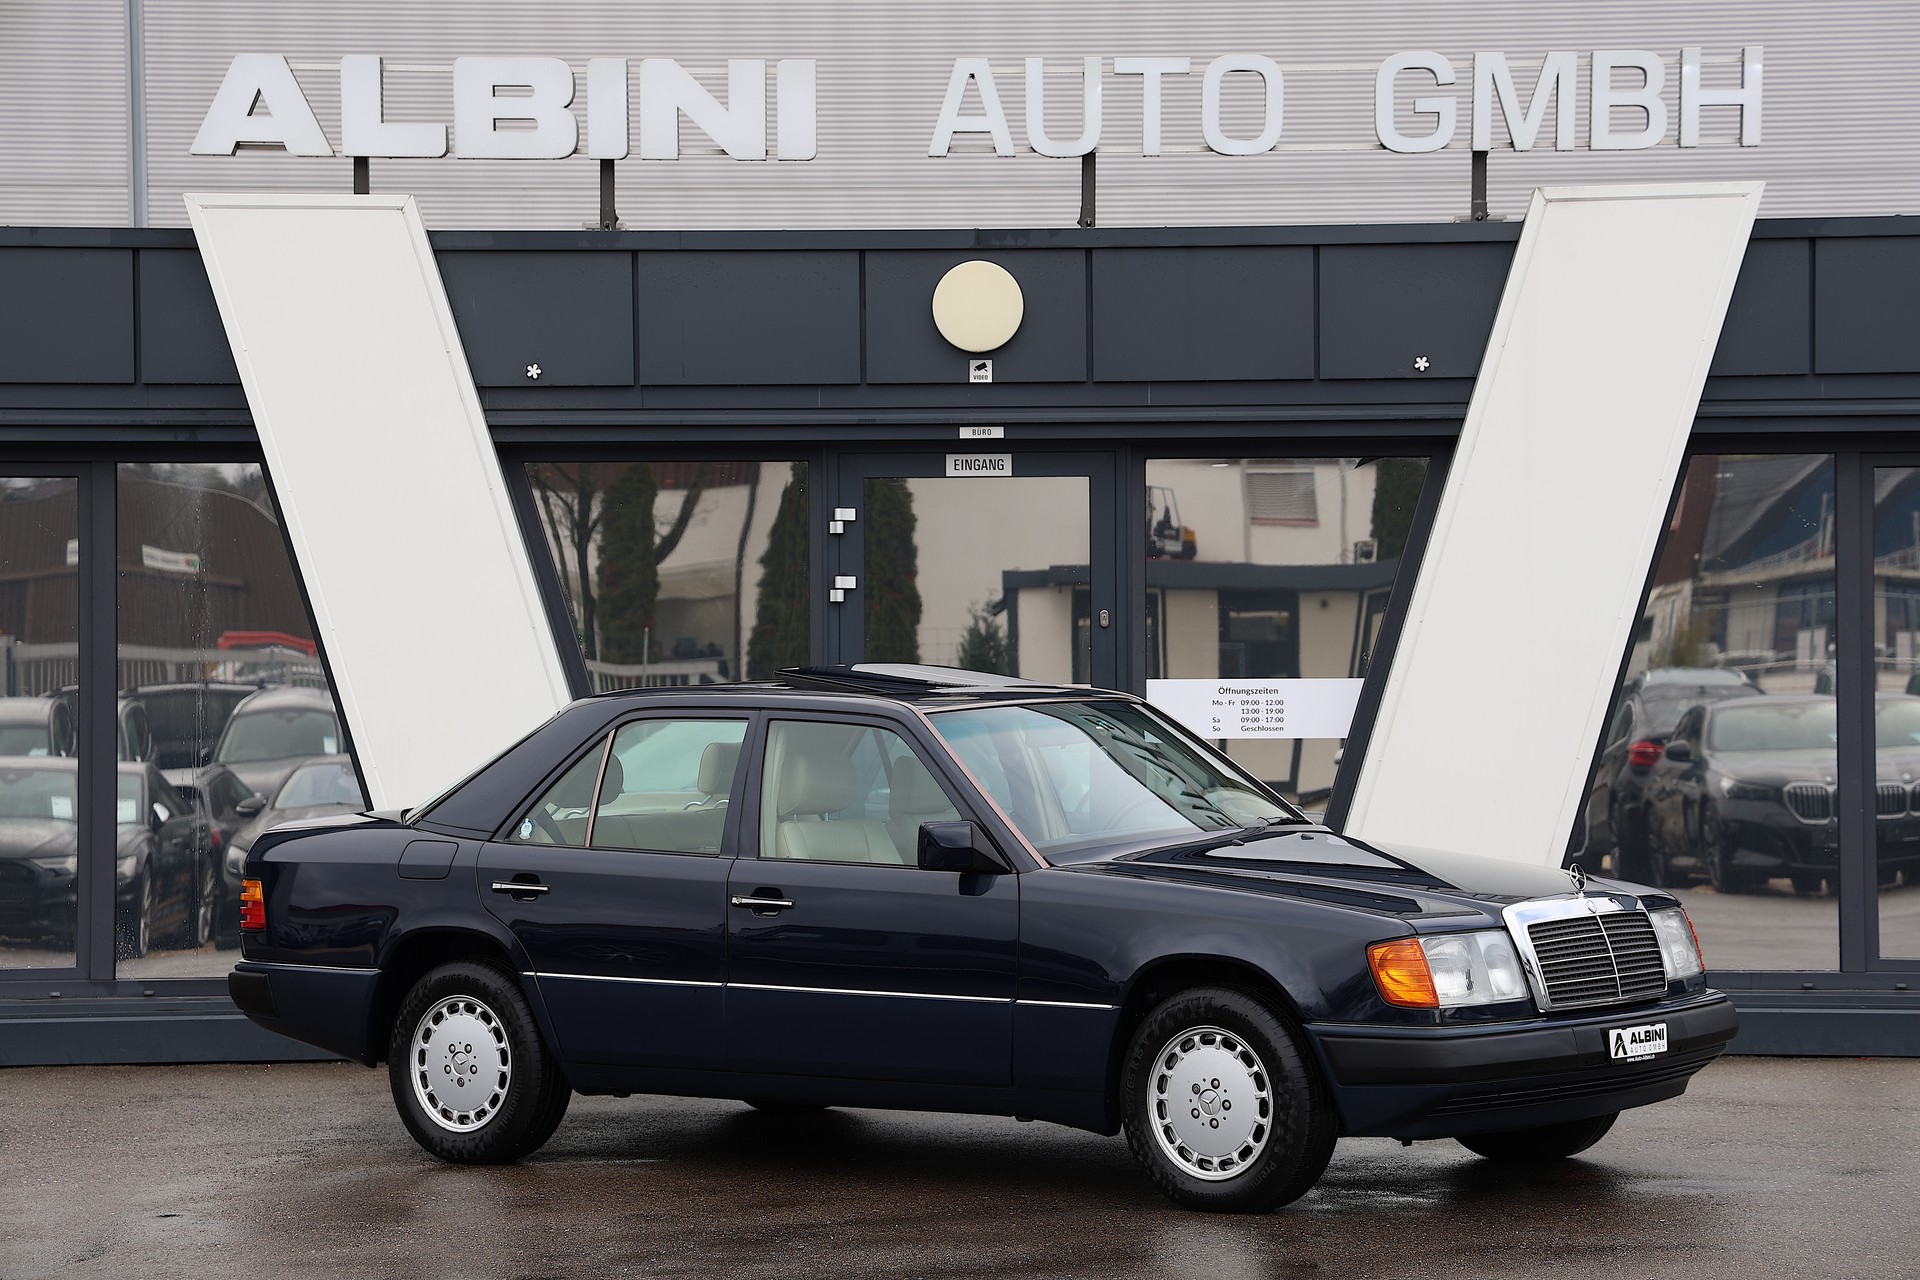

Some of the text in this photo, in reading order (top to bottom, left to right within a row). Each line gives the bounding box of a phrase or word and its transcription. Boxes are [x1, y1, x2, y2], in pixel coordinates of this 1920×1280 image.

[188, 46, 1764, 161] ALBINI AUTO GMBH
[972, 427, 992, 436] BÜRO
[954, 458, 1005, 471] EINGANG
[1218, 686, 1279, 696] Öffnungszeiten
[1630, 1028, 1665, 1045] ALBINI
[1630, 1043, 1665, 1053] AUTO GMBH
